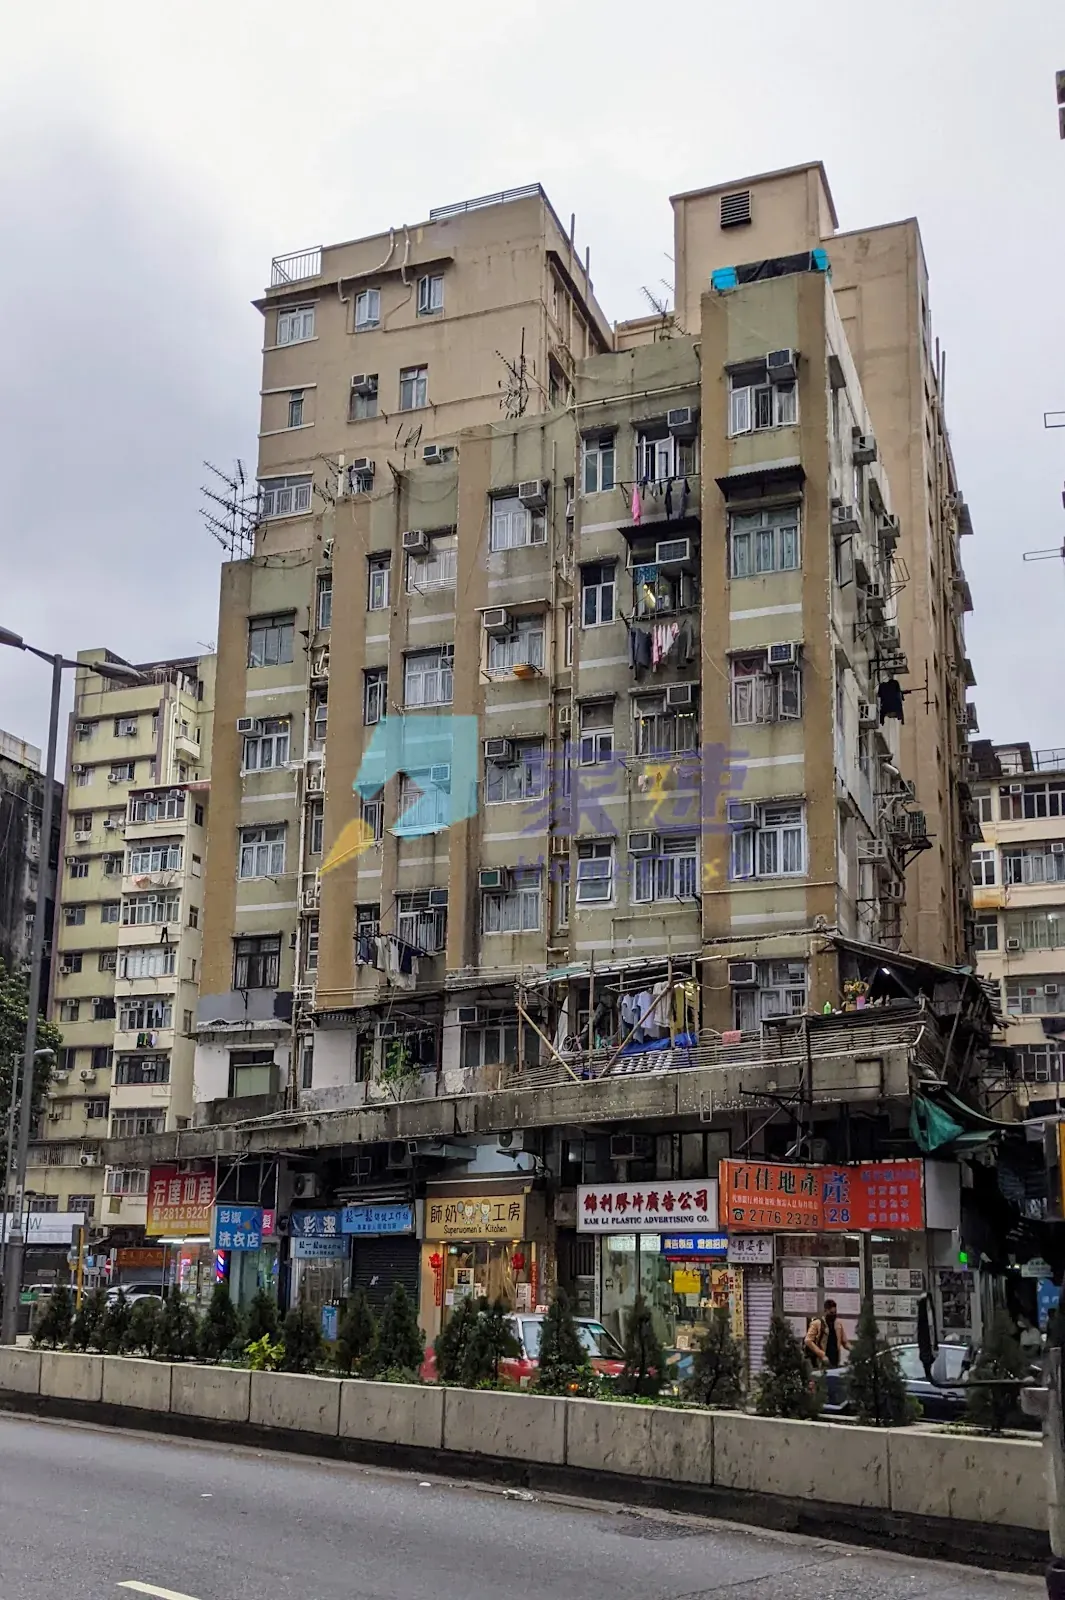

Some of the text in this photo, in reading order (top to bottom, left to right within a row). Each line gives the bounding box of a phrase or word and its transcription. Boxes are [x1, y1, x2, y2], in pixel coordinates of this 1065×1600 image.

[733, 1167, 819, 1196] 百佳地產
[153, 1176, 212, 1206] 宏達地產
[583, 1189, 708, 1214] 錦利膠片廣告公司
[187, 1206, 208, 1220] 8220
[430, 1202, 520, 1223] 師奶 工房
[583, 1214, 710, 1225] KAM LI PLASTIC ADVERTISING CO.
[750, 1209, 819, 1226] 2776 2328
[443, 1224, 508, 1237] Superwomen's Kitchen
[218, 1231, 259, 1248] 洗衣店
